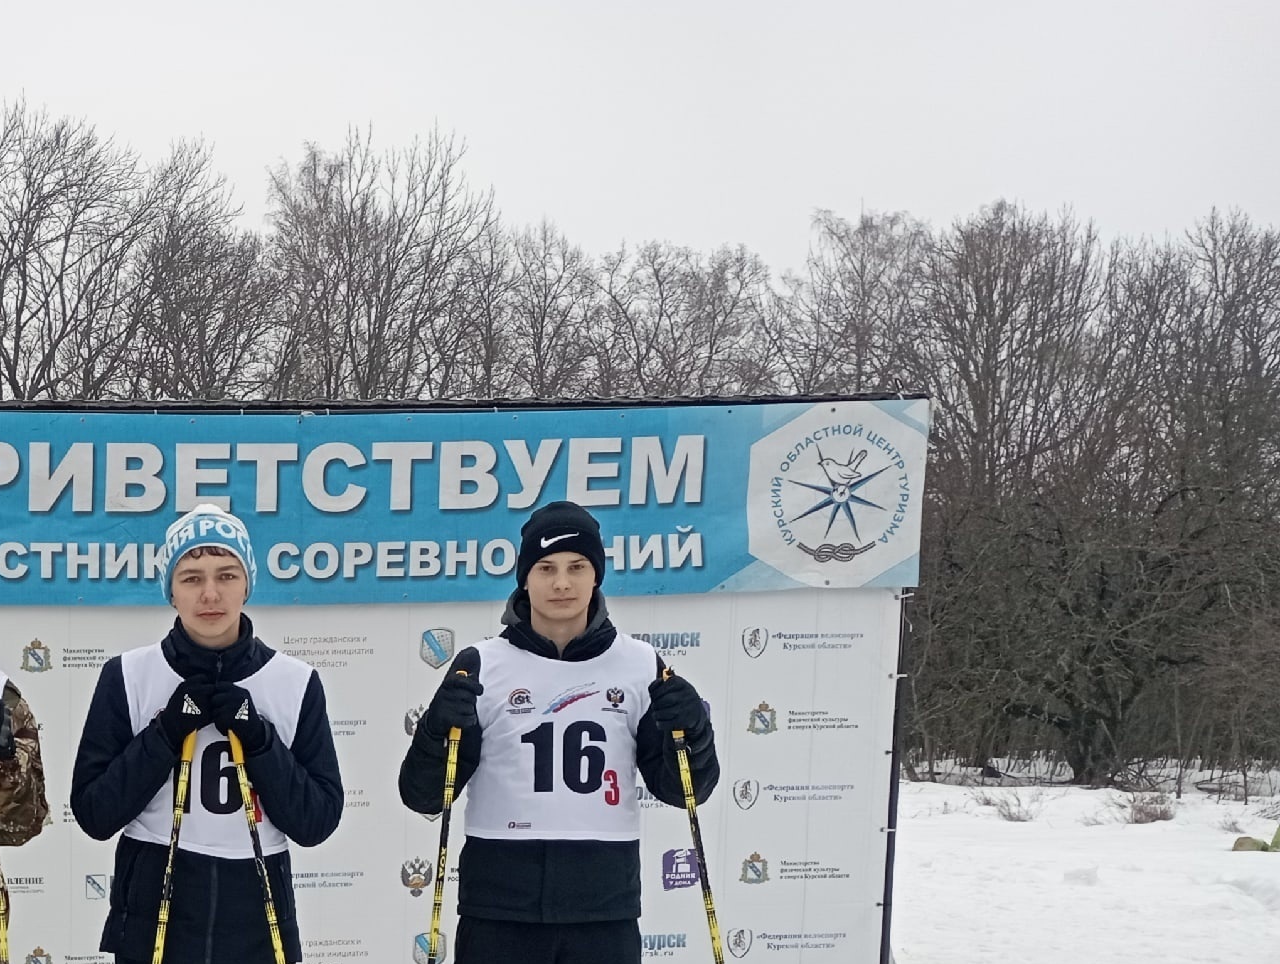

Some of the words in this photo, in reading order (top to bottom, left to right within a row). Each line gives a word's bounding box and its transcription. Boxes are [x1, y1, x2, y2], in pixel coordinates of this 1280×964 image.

[780, 424, 863, 472] ОБЛАСТНОЙ
[867, 430, 905, 470] ЦЕНТР
[771, 476, 797, 545] КУРСКИЙ
[878, 473, 910, 544] ТУРИЗМА
[267, 525, 705, 580] СОРЕВНОНИЙ
[283, 636, 308, 645] Центр
[521, 720, 607, 794] 16
[603, 770, 620, 806] 3
[7, 877, 45, 885] ВЛЕНИЕ
